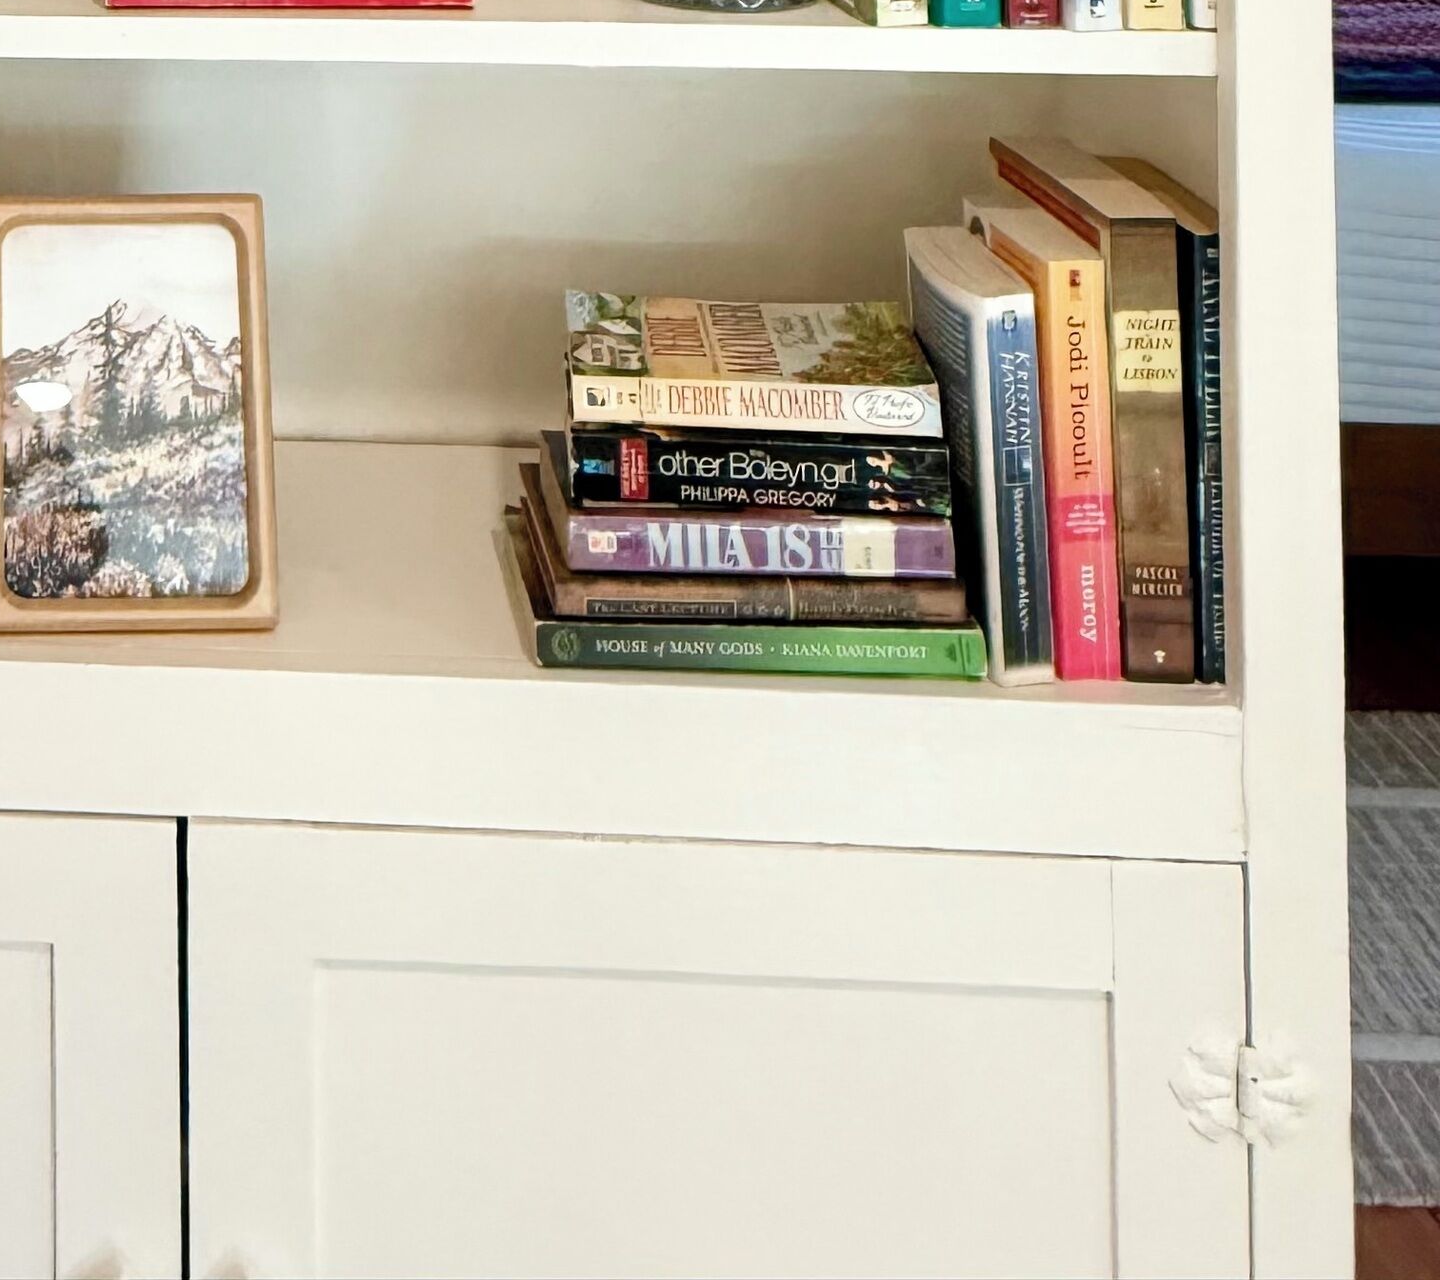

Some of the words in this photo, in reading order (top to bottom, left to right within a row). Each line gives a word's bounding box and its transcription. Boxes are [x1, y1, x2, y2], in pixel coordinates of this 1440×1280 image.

[1126, 318, 1176, 331] NIGHT
[1124, 338, 1173, 350] TRAIN
[1123, 368, 1177, 380] LISBON
[668, 386, 731, 416] DEBBIE
[739, 387, 848, 421] MACOMBER
[1000, 353, 1017, 445] HANNAH
[1016, 351, 1032, 444] KRISTIN
[660, 451, 724, 478] other
[729, 452, 819, 482] Boleyn
[681, 486, 749, 502] PHILIPPA
[754, 490, 836, 508] GREGORY
[648, 522, 750, 569] MILA
[765, 524, 812, 570] 18
